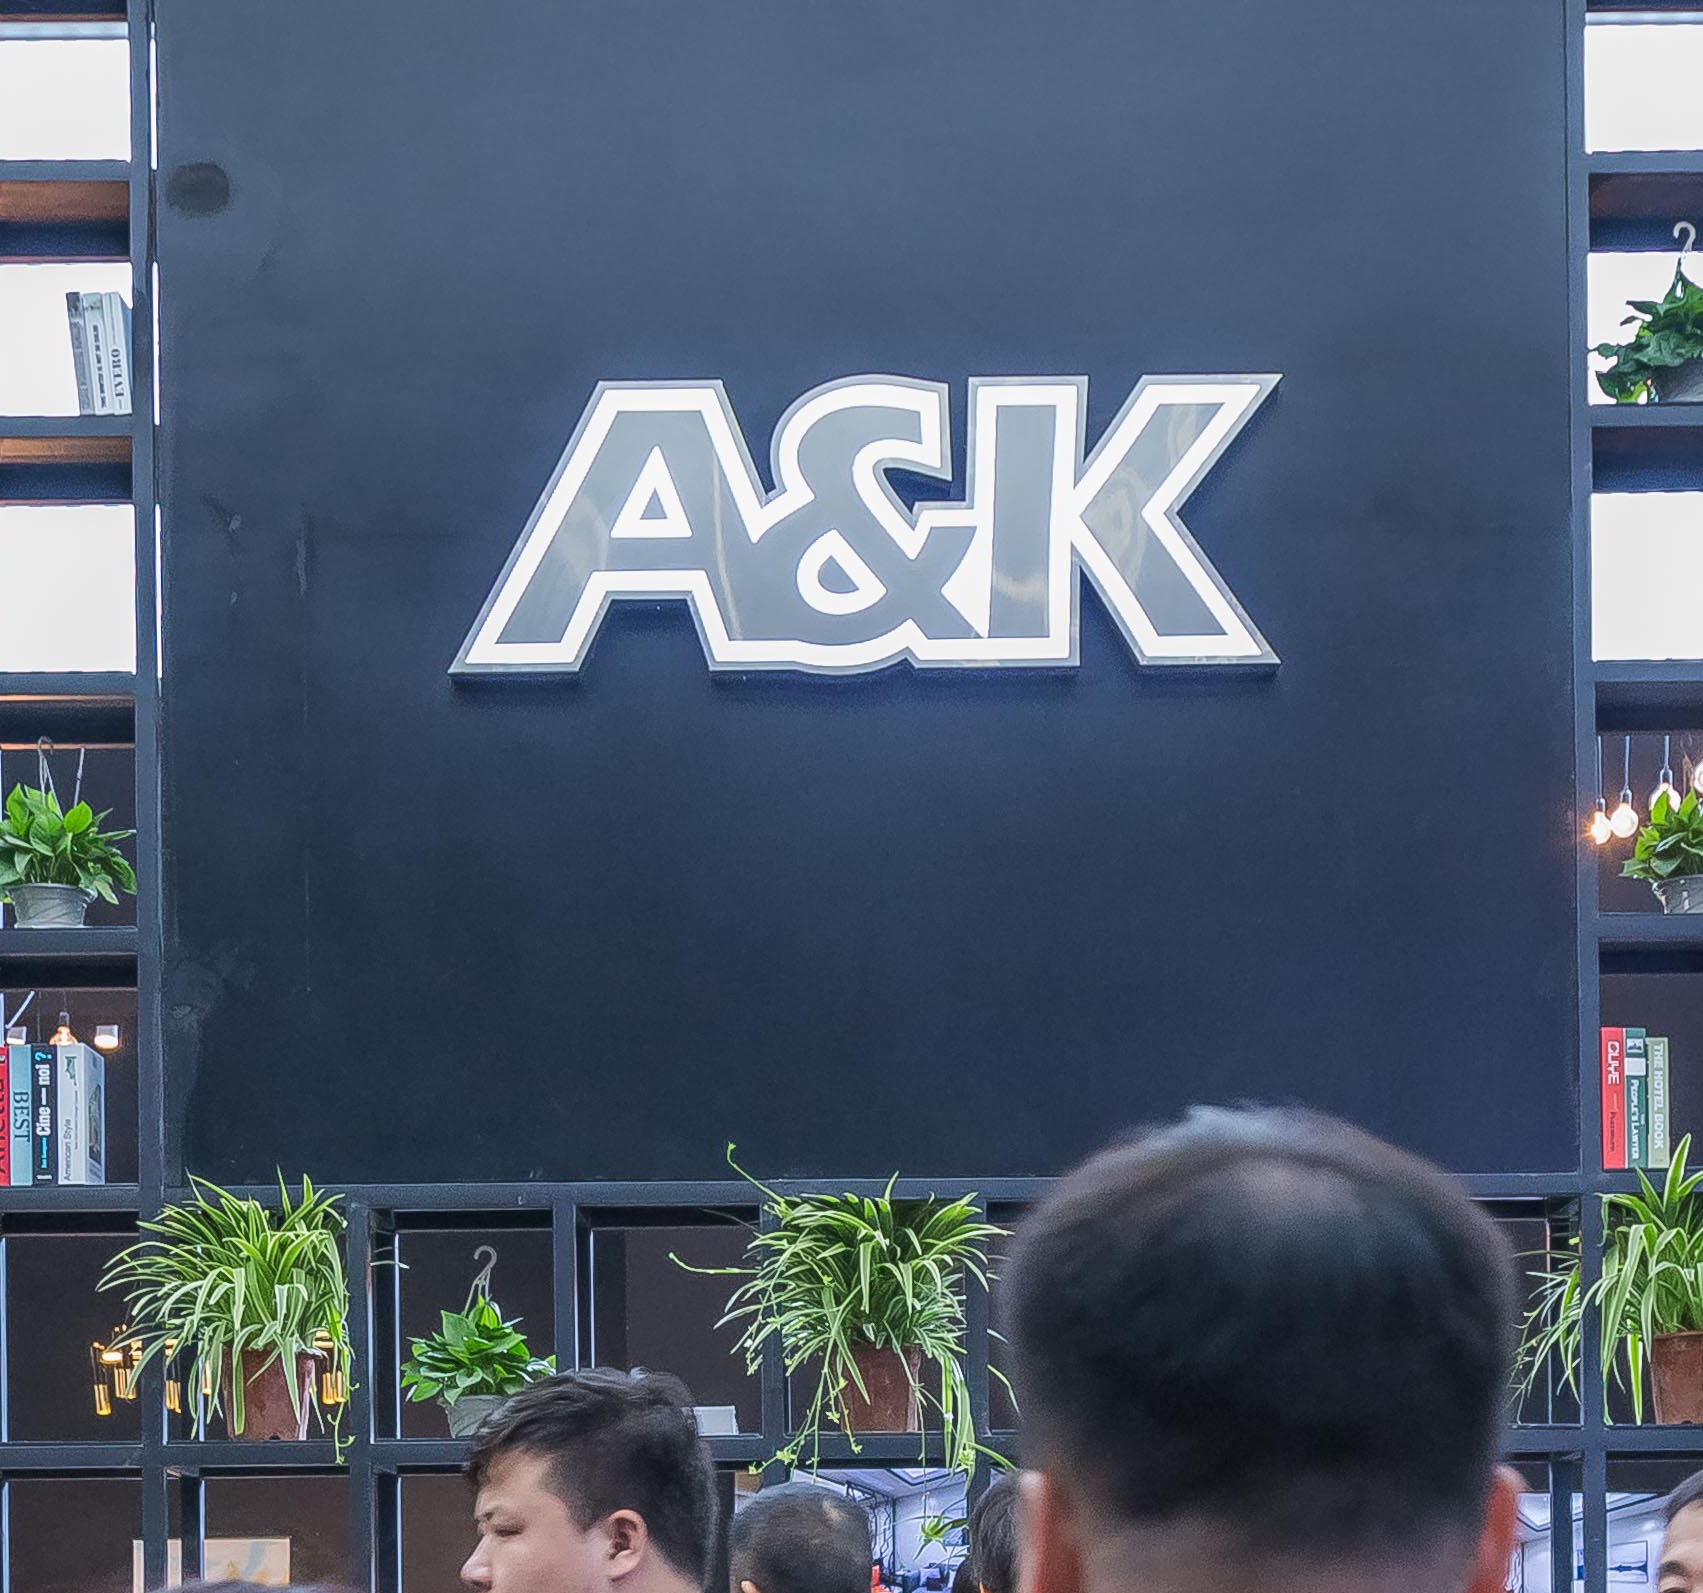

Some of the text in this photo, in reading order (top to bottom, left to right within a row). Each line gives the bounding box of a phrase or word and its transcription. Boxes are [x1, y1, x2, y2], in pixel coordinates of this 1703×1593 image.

[446, 373, 1284, 677] A&K
[14, 1090, 30, 1143] BEST
[36, 1106, 51, 1136] Cine
[1653, 1043, 1664, 1149] THE HOTEL BOOK
[64, 1118, 73, 1182] American Style
